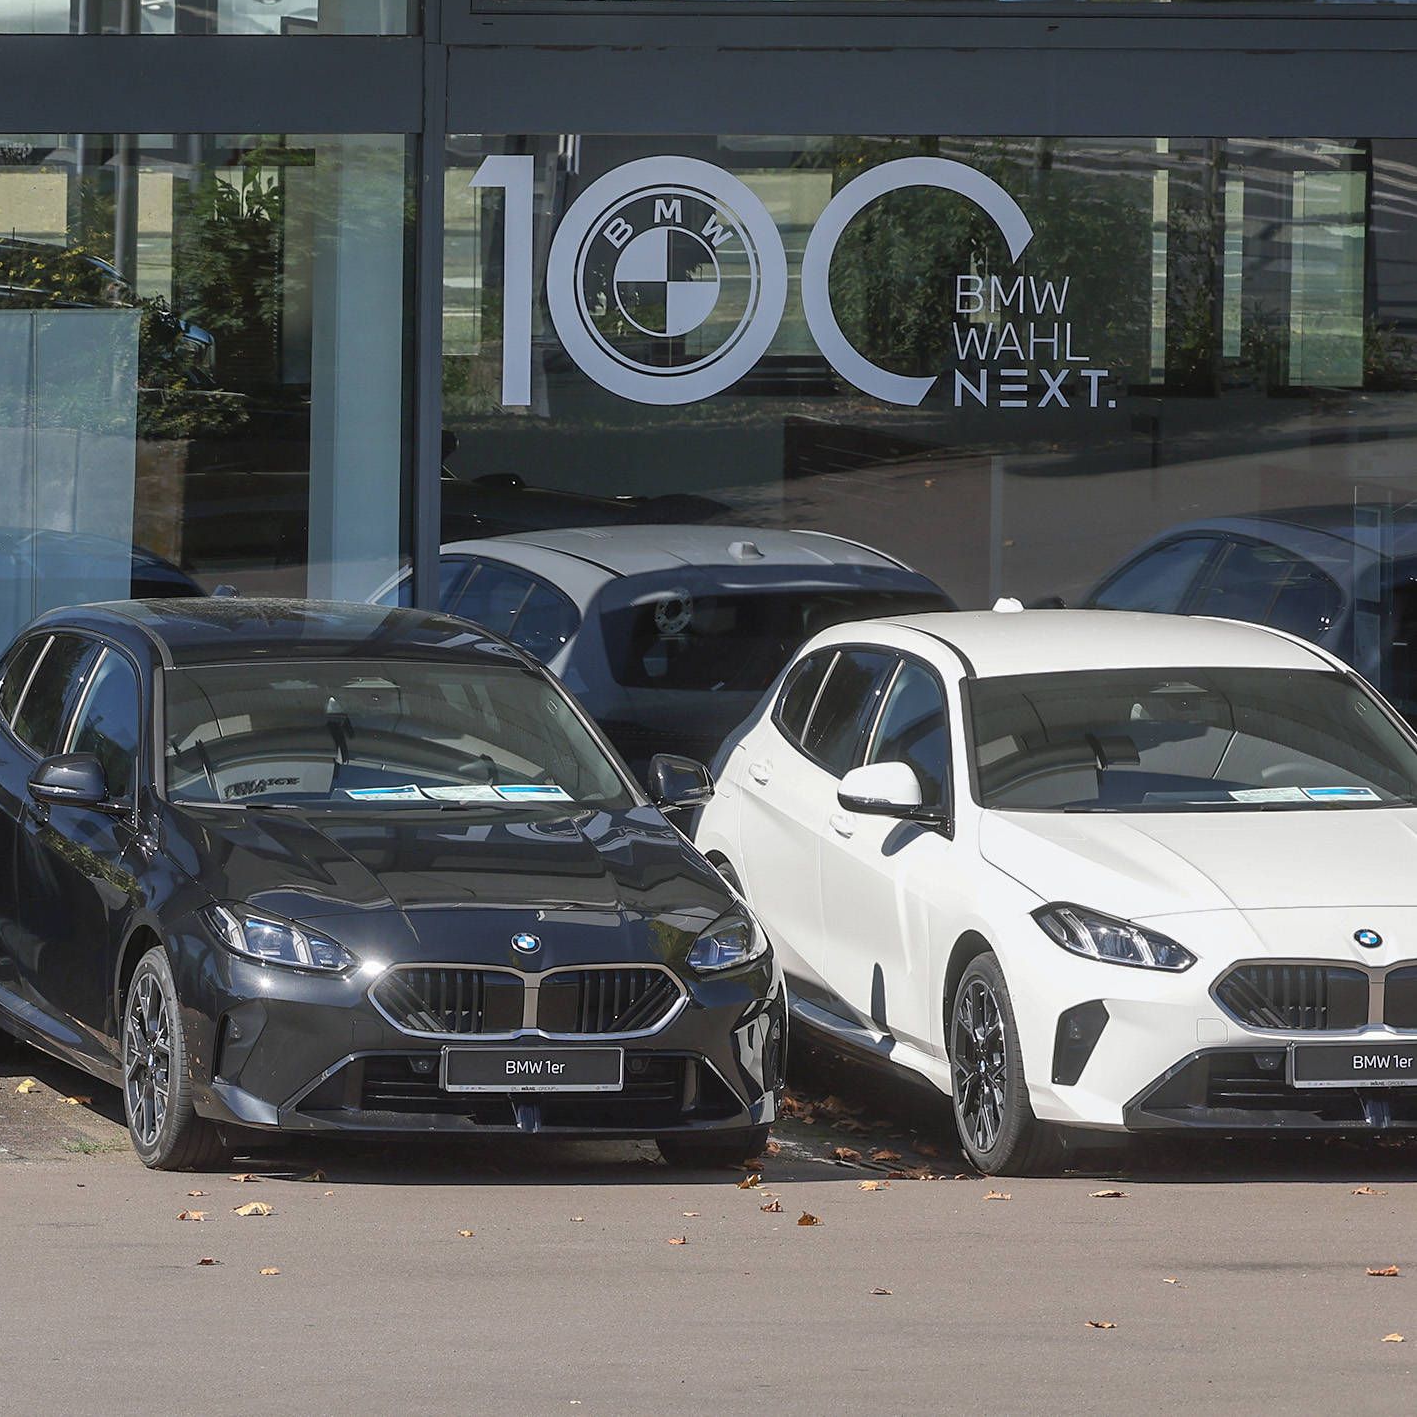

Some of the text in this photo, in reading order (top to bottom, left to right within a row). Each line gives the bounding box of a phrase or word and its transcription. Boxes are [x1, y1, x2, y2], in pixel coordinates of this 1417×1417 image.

[603, 198, 734, 249] BMW
[954, 276, 1070, 315] BMW
[953, 323, 1090, 362] WAHL
[953, 368, 1118, 409] NEXT.
[506, 1061, 565, 1074] BMW 1er
[1353, 1055, 1413, 1069] BMW 1er
